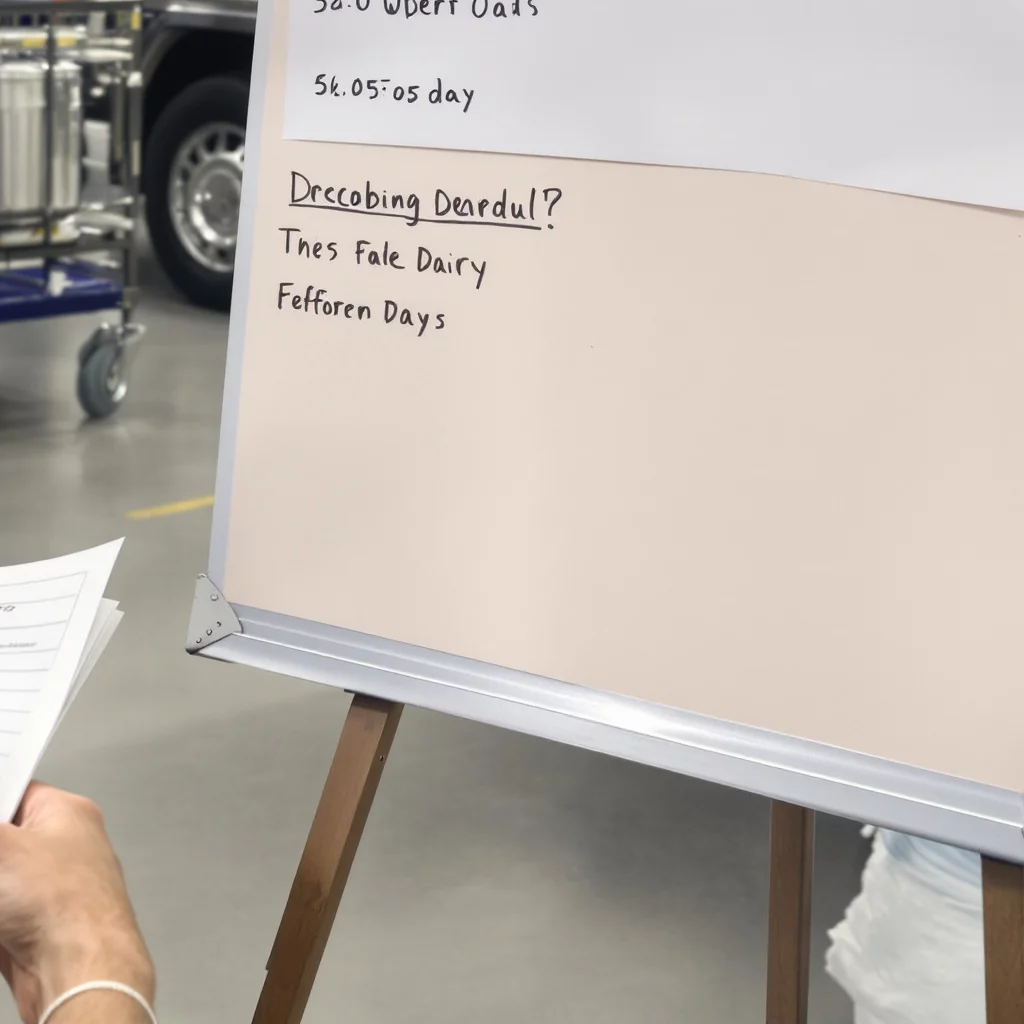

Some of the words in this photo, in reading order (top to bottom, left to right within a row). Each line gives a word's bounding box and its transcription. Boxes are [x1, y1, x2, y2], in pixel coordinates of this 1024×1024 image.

[354, 239, 407, 270] Fale
[416, 246, 488, 290] Dairy
[383, 299, 447, 338] Days
